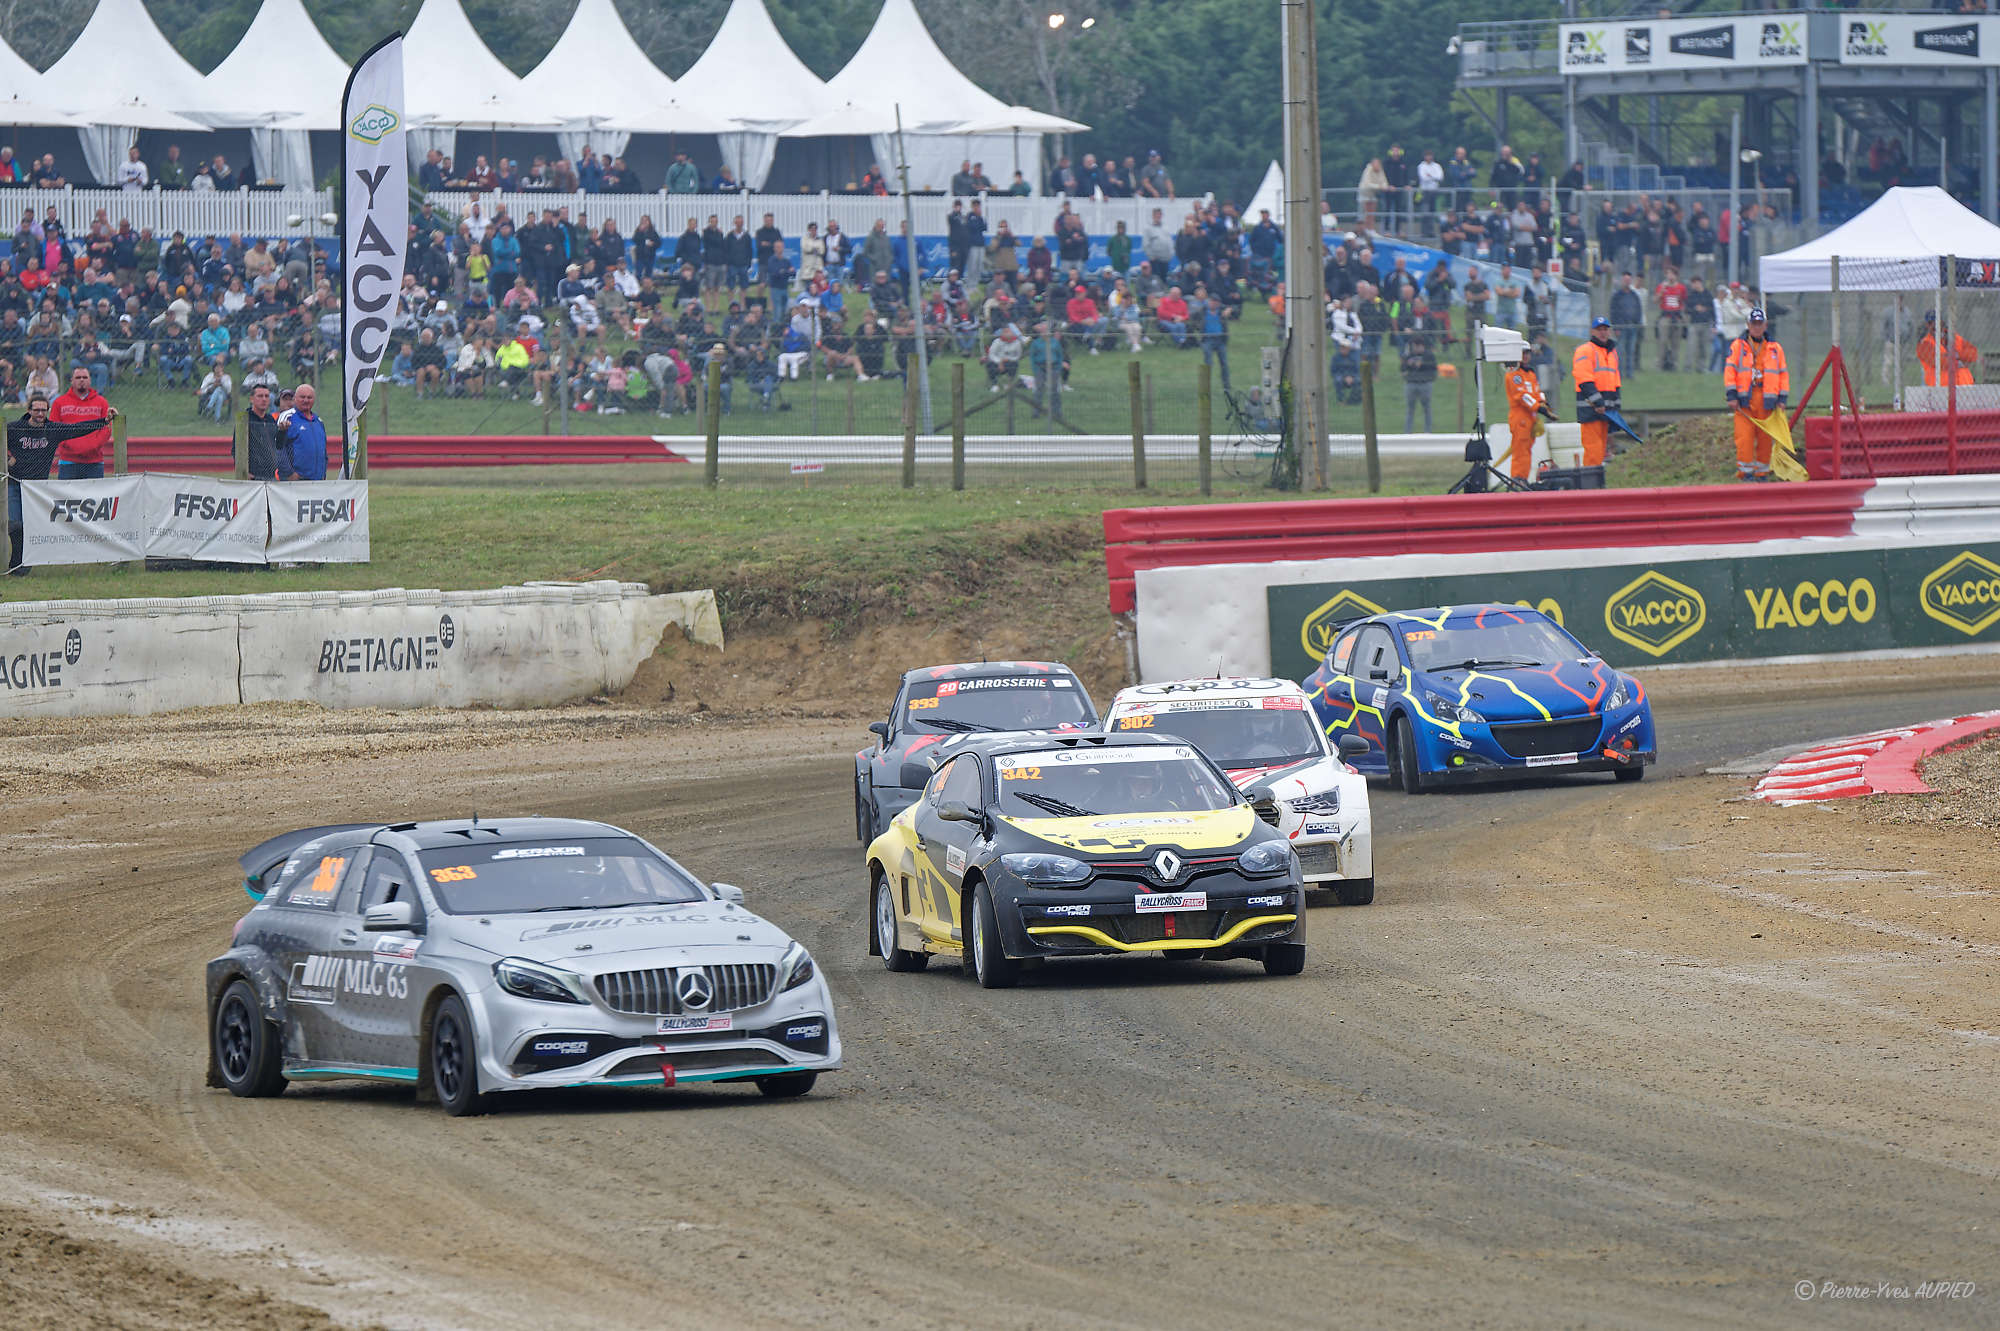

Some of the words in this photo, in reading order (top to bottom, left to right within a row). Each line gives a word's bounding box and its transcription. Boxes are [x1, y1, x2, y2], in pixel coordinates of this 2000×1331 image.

[1936, 579, 2000, 606] YACCO
[1744, 577, 1877, 629] YACCO
[1620, 600, 1691, 627] YACCO
[318, 635, 438, 673] BRETAGNE
[958, 678, 1047, 691] CARROSSERIE
[909, 697, 939, 710] 393
[1120, 715, 1155, 730] 302
[1002, 767, 1042, 780] 342
[430, 866, 477, 882] 363
[1141, 897, 1182, 907] RALLYCROSS
[1248, 896, 1282, 904] COOPER
[635, 915, 709, 923] MLC
[719, 915, 758, 924] 63
[344, 959, 384, 995] MLC
[387, 965, 408, 999] 63
[662, 1018, 708, 1029] RALLYCROSS
[787, 1025, 822, 1034] COOPER
[535, 1042, 588, 1050] COOPER
